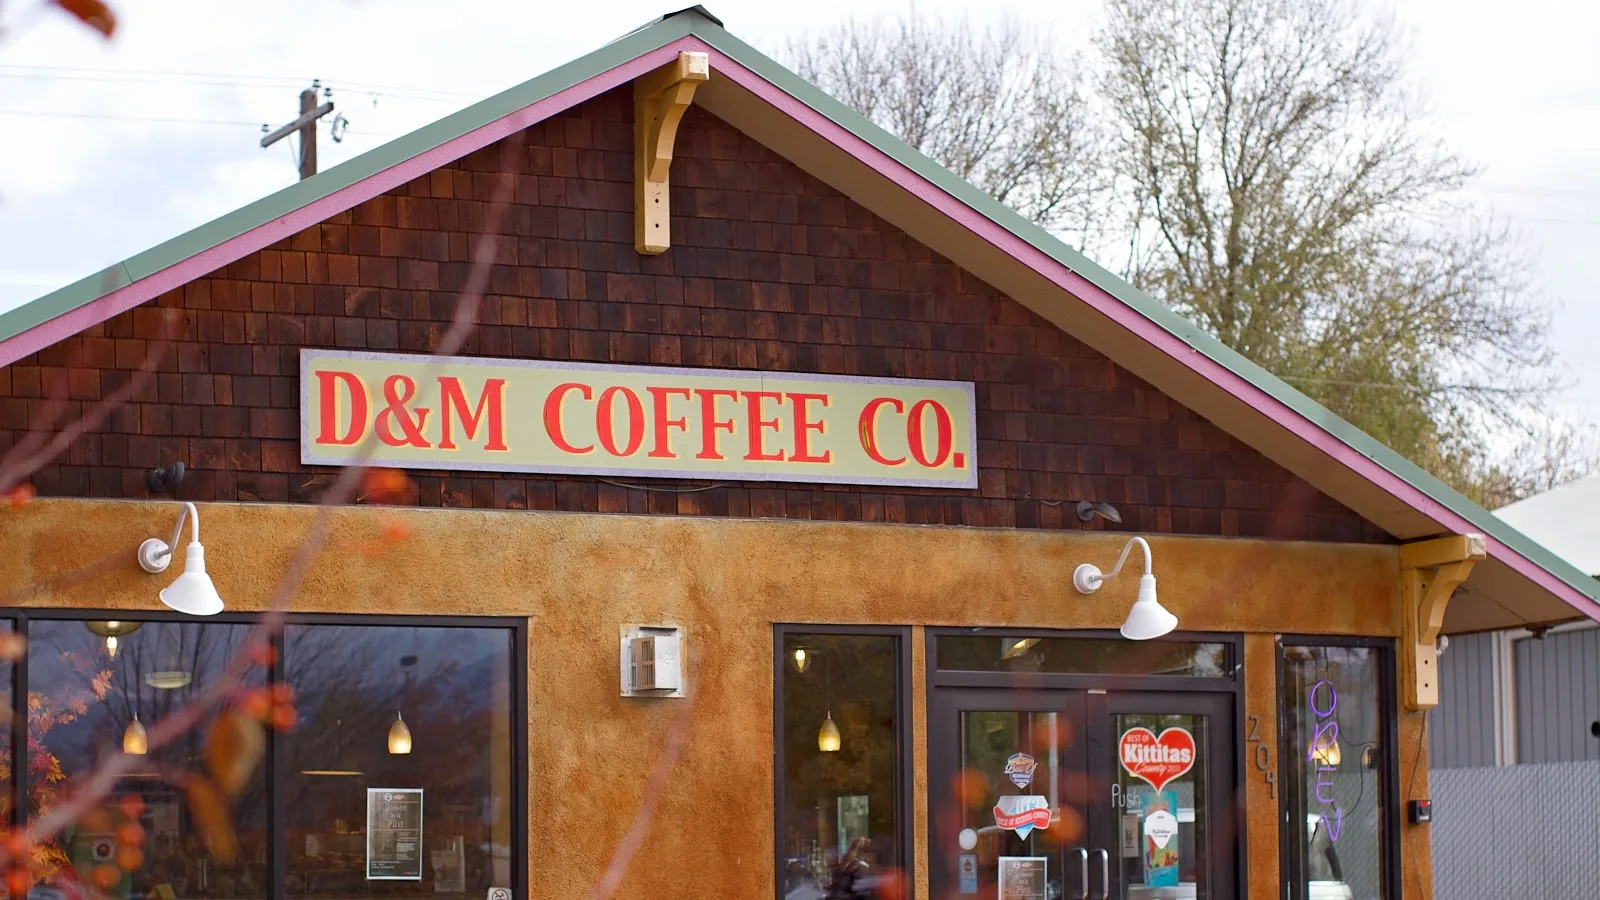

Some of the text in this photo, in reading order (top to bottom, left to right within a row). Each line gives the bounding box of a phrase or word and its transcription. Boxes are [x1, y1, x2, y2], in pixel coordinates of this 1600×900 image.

[315, 370, 966, 469] D&M COFFEE CO.
[1127, 734, 1150, 743] BEST OF
[1124, 743, 1191, 763] Kittitas
[1247, 714, 1277, 800] 204
[1307, 679, 1342, 842] OPEN
[1134, 762, 1166, 777] County
[1111, 783, 1141, 809] Push
